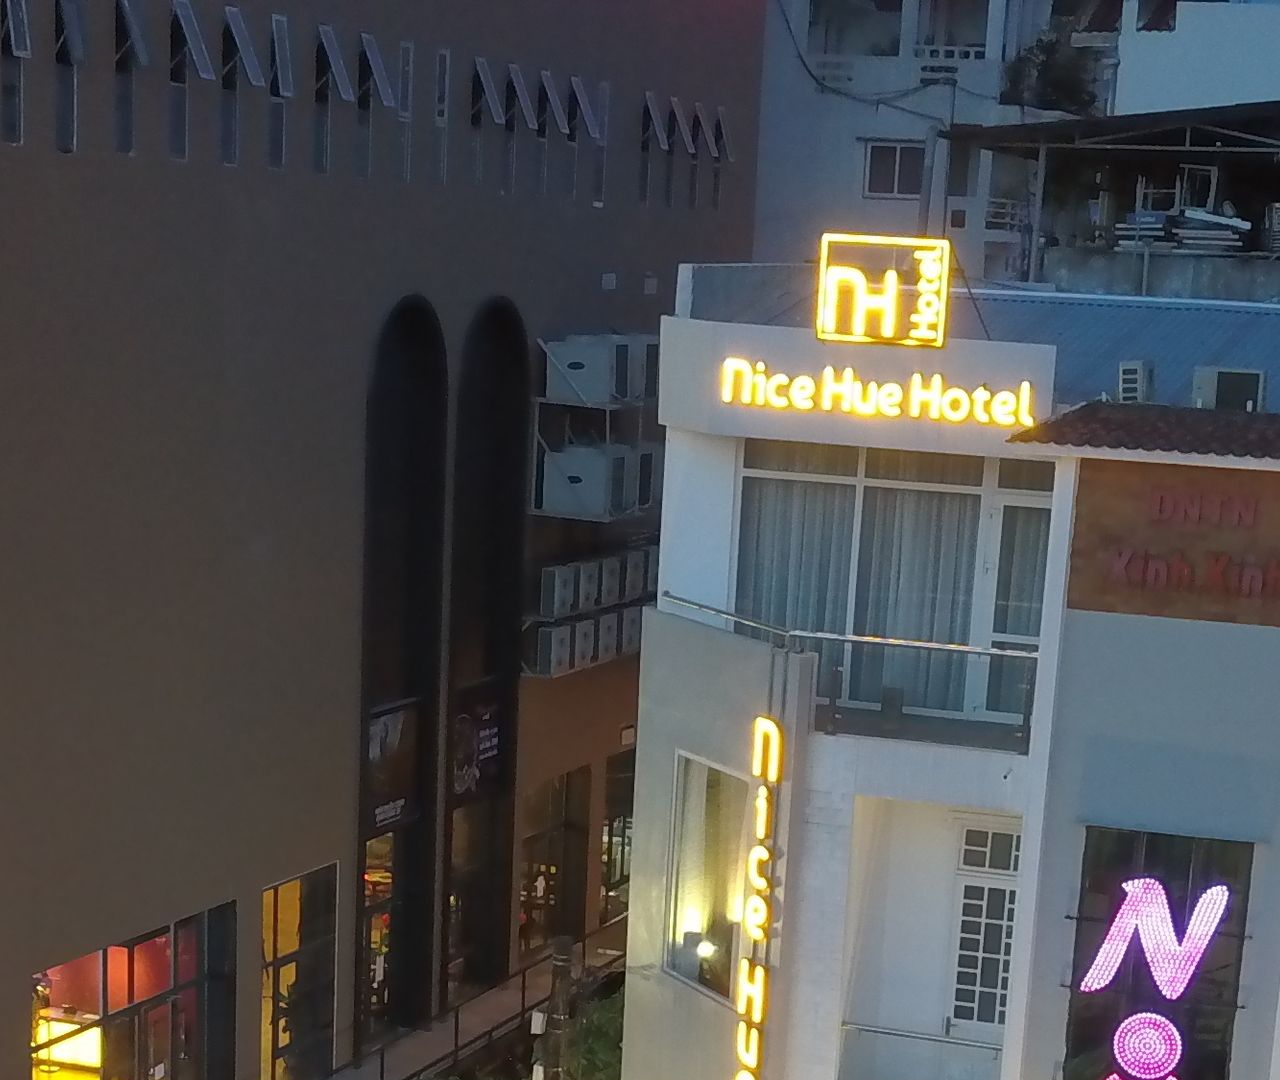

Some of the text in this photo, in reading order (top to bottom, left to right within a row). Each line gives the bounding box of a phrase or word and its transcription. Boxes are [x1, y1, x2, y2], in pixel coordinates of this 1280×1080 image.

[908, 246, 942, 341] Hotel
[820, 364, 904, 418] Hue
[907, 372, 1035, 428] Hotel
